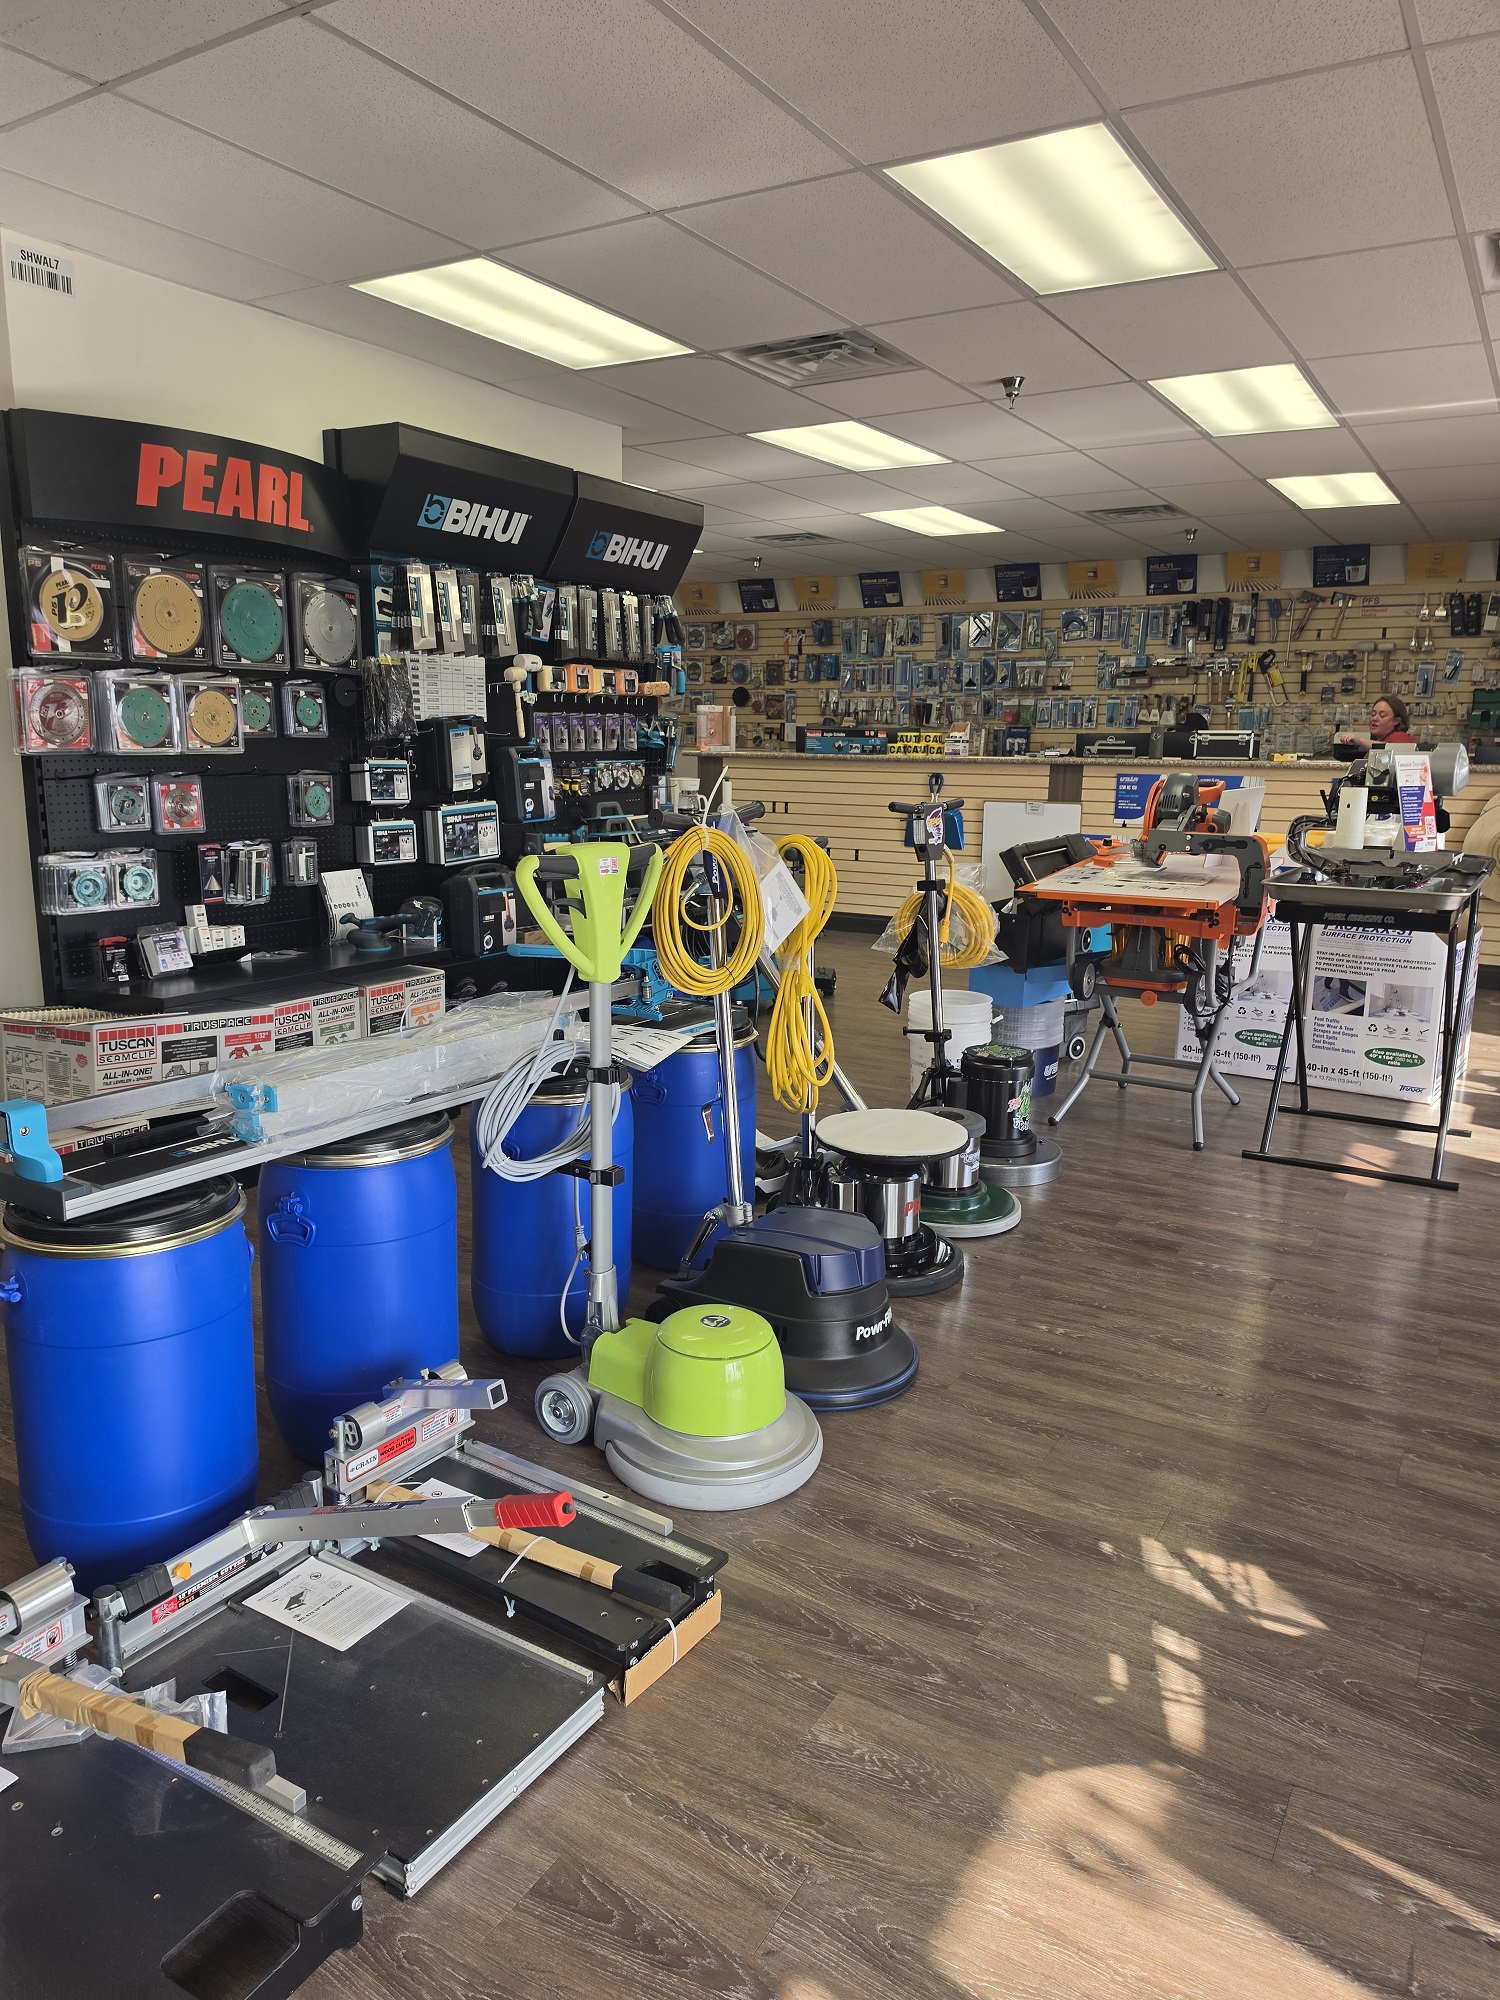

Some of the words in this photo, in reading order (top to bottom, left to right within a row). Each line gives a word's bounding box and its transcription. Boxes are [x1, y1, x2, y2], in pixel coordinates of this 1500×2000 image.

[20, 250, 59, 270] SHWAL7
[136, 443, 309, 531] PEARL
[442, 498, 529, 545] BIHUI
[603, 534, 669, 570] BIHUI
[1362, 596, 1380, 604] PFS
[195, 647, 205, 655] 10"
[1321, 931, 1356, 940] SURFACE
[1358, 934, 1412, 944] PROTECTION
[371, 992, 404, 1006] TUSCAN
[318, 1004, 356, 1018] ALL-IN-ONE!
[370, 1002, 405, 1014] SEAMCLIP
[184, 1016, 251, 1032] TRUSPACE
[1313, 1027, 1331, 1035] Scrapes
[99, 1036, 154, 1052] TUSCAN
[1312, 1044, 1341, 1052] Construction
[99, 1050, 155, 1064] SEAMCLIP
[1214, 1050, 1230, 1058] 5-ft
[103, 1067, 153, 1080] ALL-IN-ONE!
[1306, 1063, 1328, 1073] 40-in
[1338, 1068, 1360, 1078] 45-ft
[355, 1454, 377, 1471] CRAIN
[380, 1445, 394, 1457] WOOD
[396, 1435, 415, 1449] CUTTER
[188, 1573, 219, 1596] PREMIUM
[220, 1557, 245, 1574] CUTTER
[257, 1581, 291, 1602] INSTRUCTIONS
[335, 1585, 353, 1597] CUTTER
